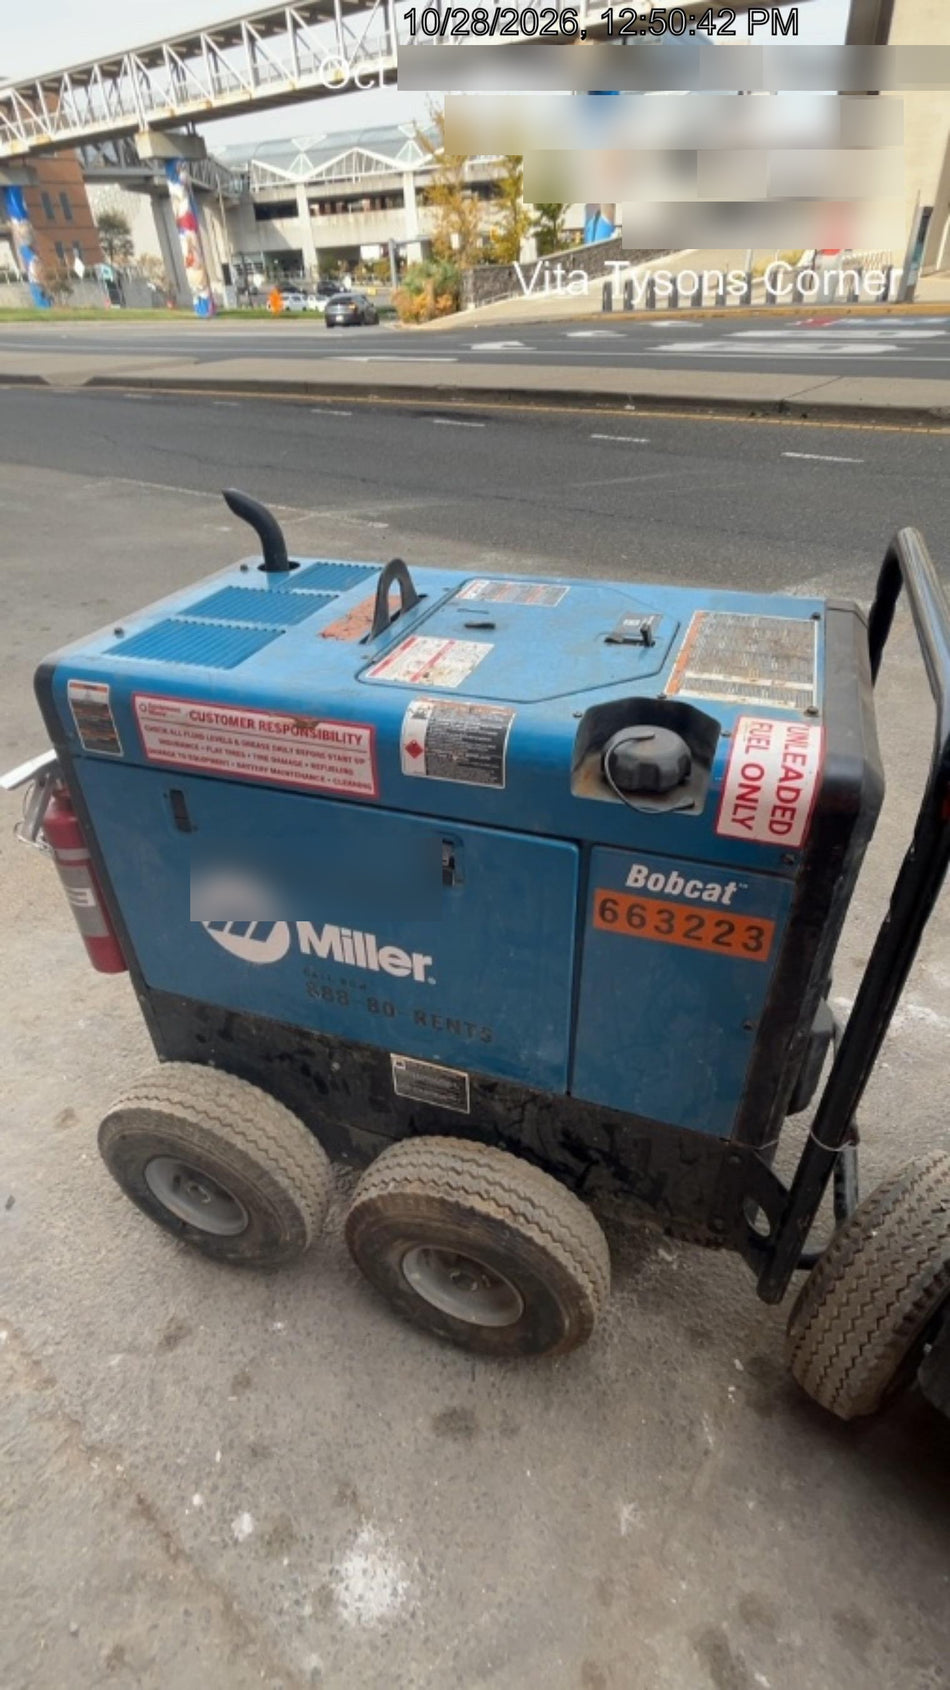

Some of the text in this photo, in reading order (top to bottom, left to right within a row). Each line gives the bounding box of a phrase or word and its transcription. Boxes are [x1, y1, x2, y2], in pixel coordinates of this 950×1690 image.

[189, 709, 256, 729] CUSTOMER
[258, 719, 363, 745] RESPONSIBILITY
[731, 721, 773, 831] FUEL ONLY
[768, 725, 810, 836] UNLEADED
[625, 863, 738, 905] Bobcat
[296, 920, 432, 982] Miller
[599, 897, 765, 952] 663223
